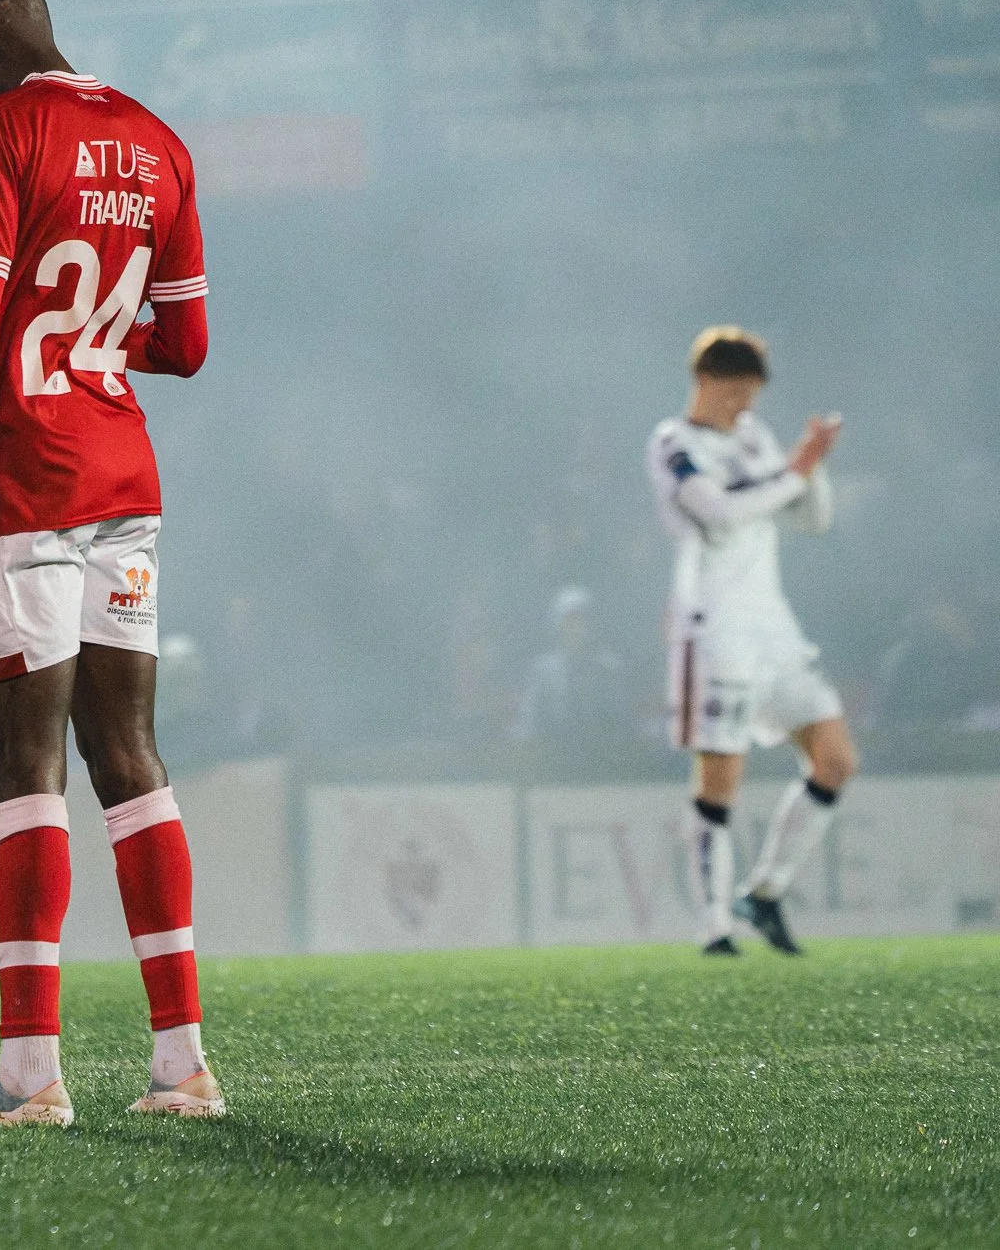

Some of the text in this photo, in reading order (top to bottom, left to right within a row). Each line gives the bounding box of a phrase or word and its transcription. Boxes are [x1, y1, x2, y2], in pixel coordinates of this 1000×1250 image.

[75, 140, 137, 179] ATU
[79, 190, 156, 230] TRAORE
[21, 239, 153, 397] 24
[107, 608, 136, 617] DISCOUNT
